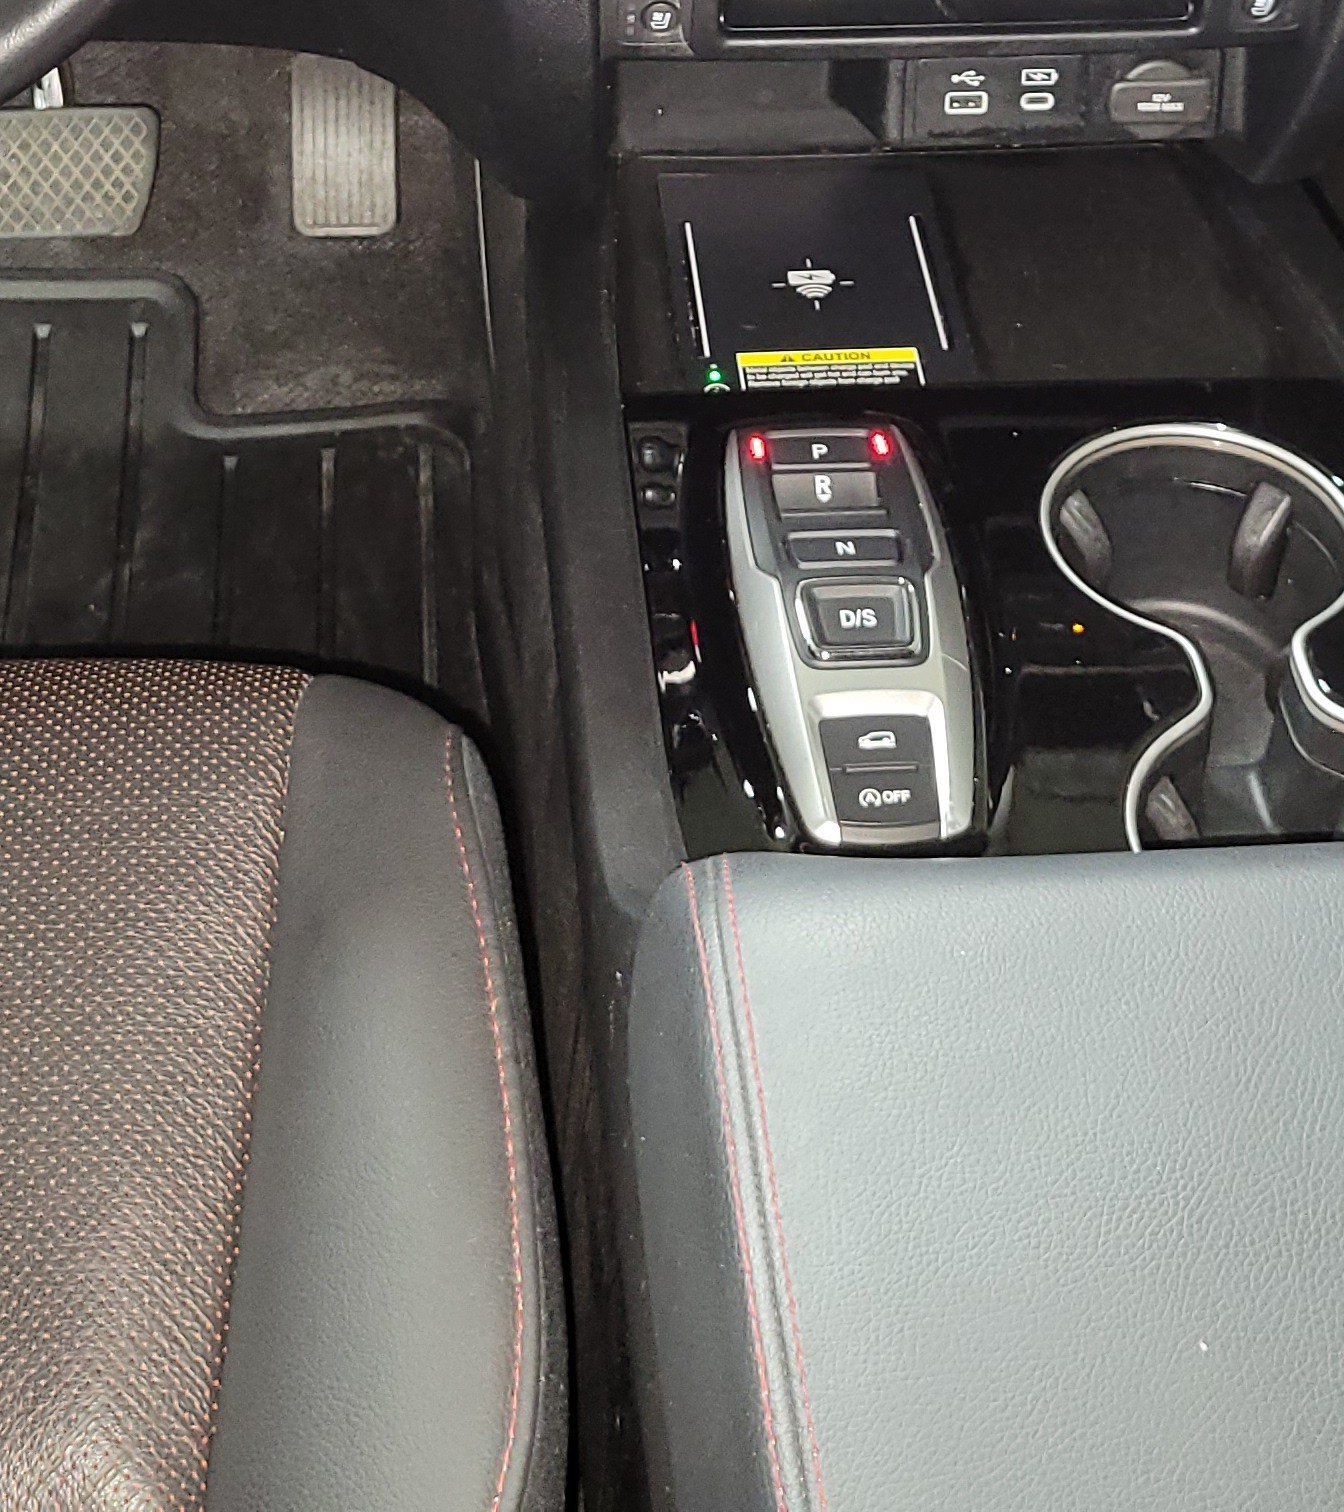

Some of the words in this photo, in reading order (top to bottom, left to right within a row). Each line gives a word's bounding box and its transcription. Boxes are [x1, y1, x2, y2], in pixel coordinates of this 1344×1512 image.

[801, 351, 872, 362] CAUTION
[812, 443, 828, 459] P
[814, 474, 832, 495] R
[835, 541, 856, 556] N
[839, 608, 877, 629] D/S
[881, 788, 912, 805] OFF
